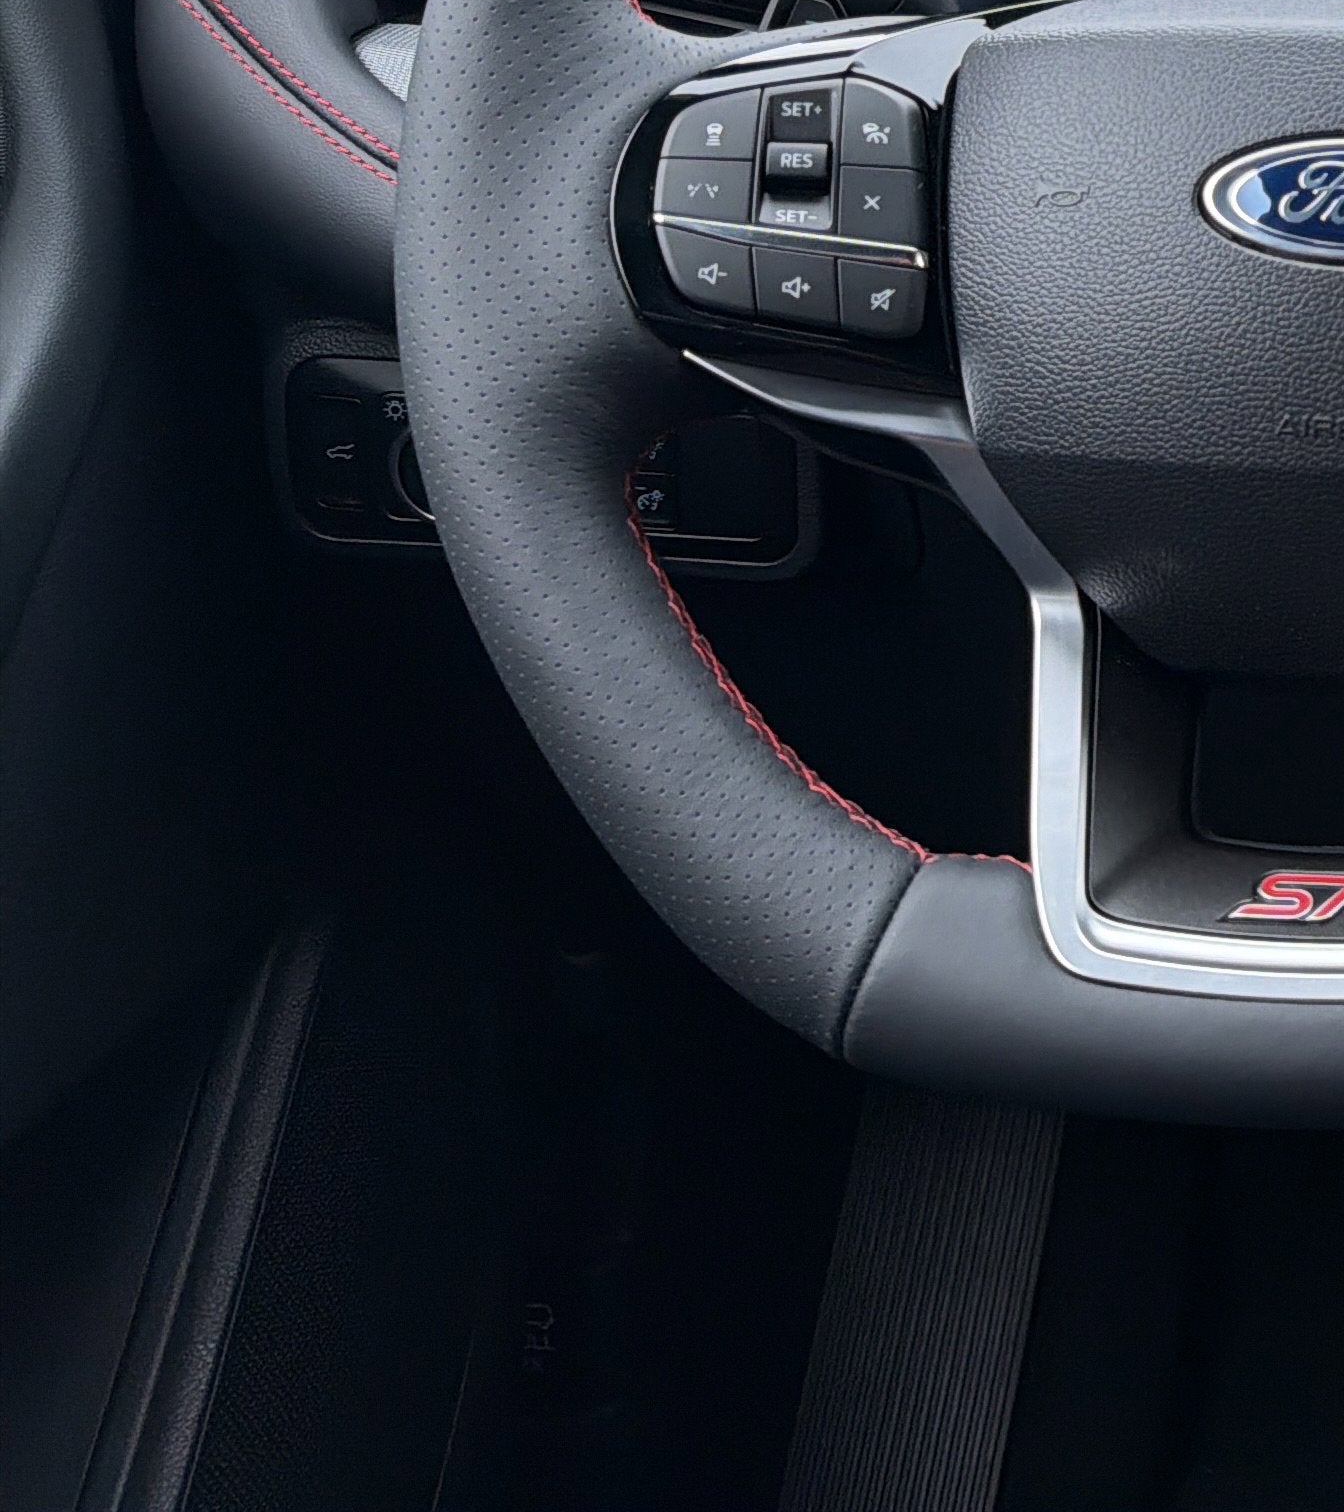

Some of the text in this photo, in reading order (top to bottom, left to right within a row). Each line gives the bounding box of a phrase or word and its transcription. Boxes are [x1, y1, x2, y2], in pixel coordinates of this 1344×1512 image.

[781, 101, 823, 117] SET+
[780, 153, 813, 168] RES
[775, 209, 818, 223] SET-
